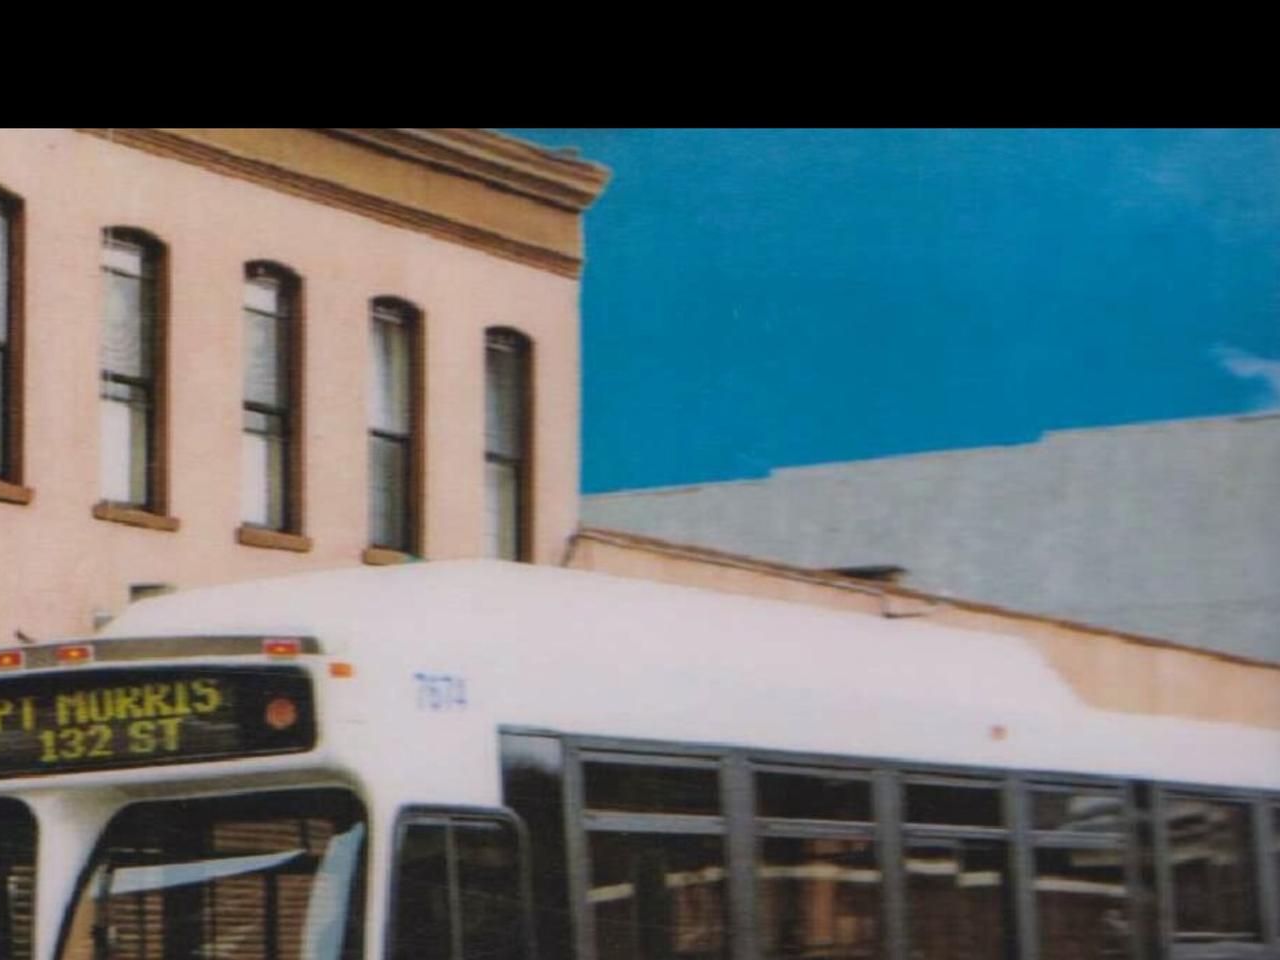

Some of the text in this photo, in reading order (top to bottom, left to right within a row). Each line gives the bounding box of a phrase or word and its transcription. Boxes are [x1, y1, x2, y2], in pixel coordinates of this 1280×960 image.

[55, 677, 222, 726] MORRIS
[41, 717, 185, 763] 132 ST
